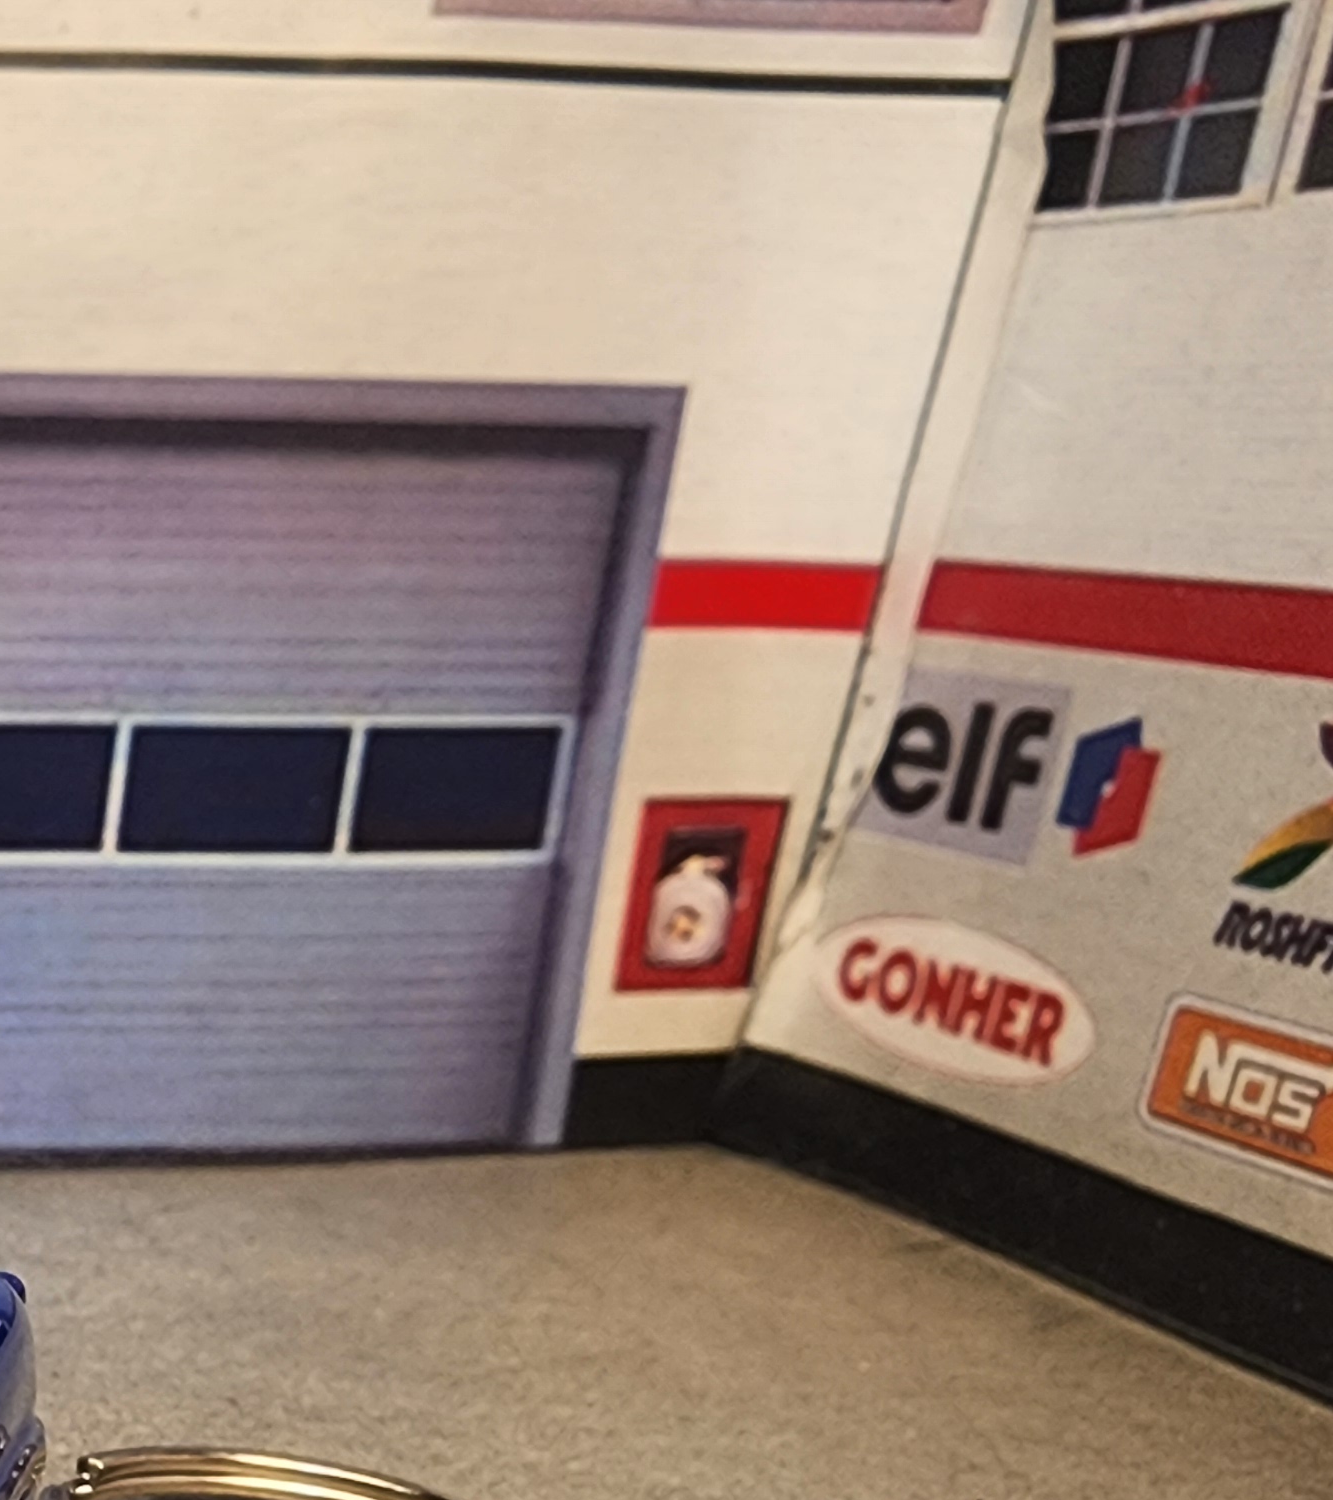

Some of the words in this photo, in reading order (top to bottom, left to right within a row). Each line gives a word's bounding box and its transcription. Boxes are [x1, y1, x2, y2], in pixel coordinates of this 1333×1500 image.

[874, 701, 1054, 831] elf
[1213, 900, 1333, 974] ROSHF
[1185, 1029, 1322, 1133] NOS
